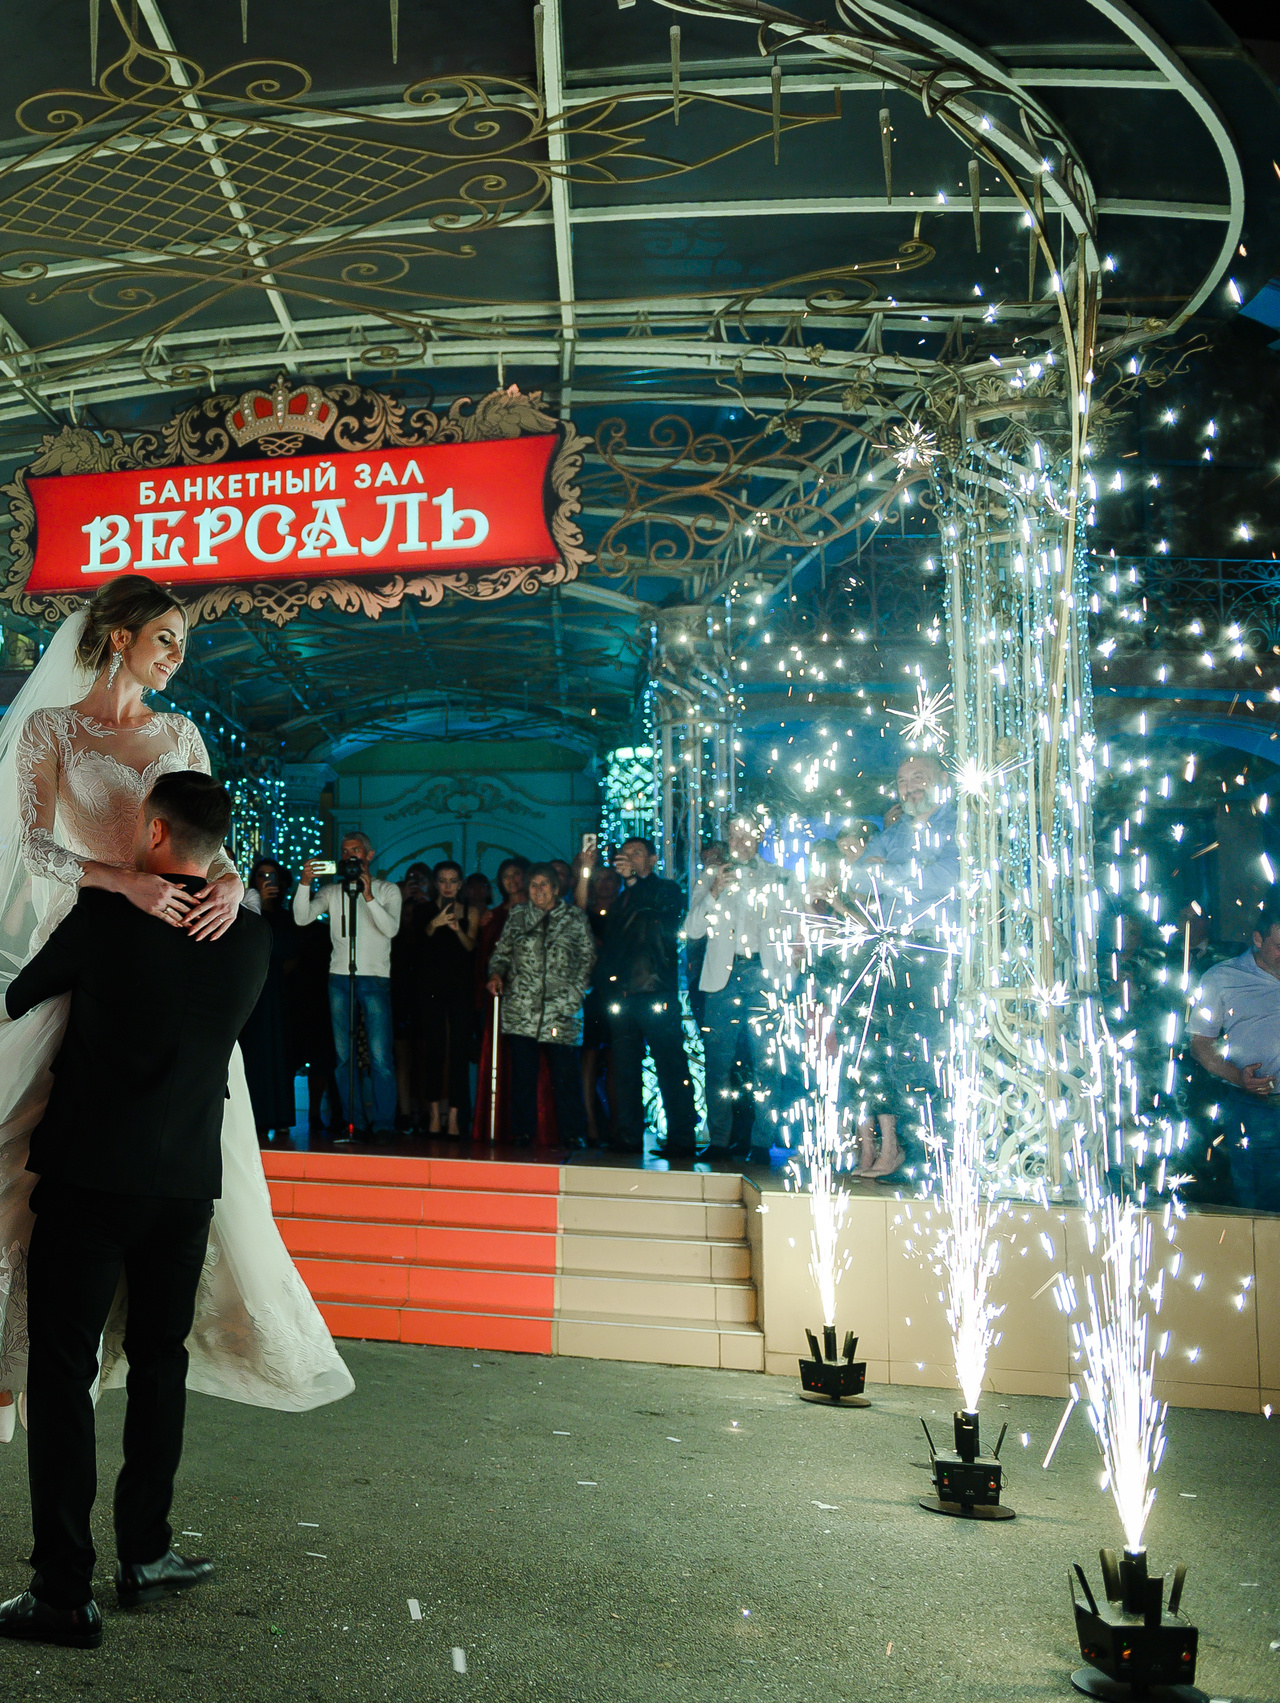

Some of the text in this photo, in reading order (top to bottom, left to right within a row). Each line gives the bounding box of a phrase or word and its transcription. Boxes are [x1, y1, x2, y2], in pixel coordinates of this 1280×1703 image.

[139, 459, 425, 505] БАНКЕТНЫЙ ЗАЛ
[80, 487, 490, 574] ВЕРСАЛЬ
